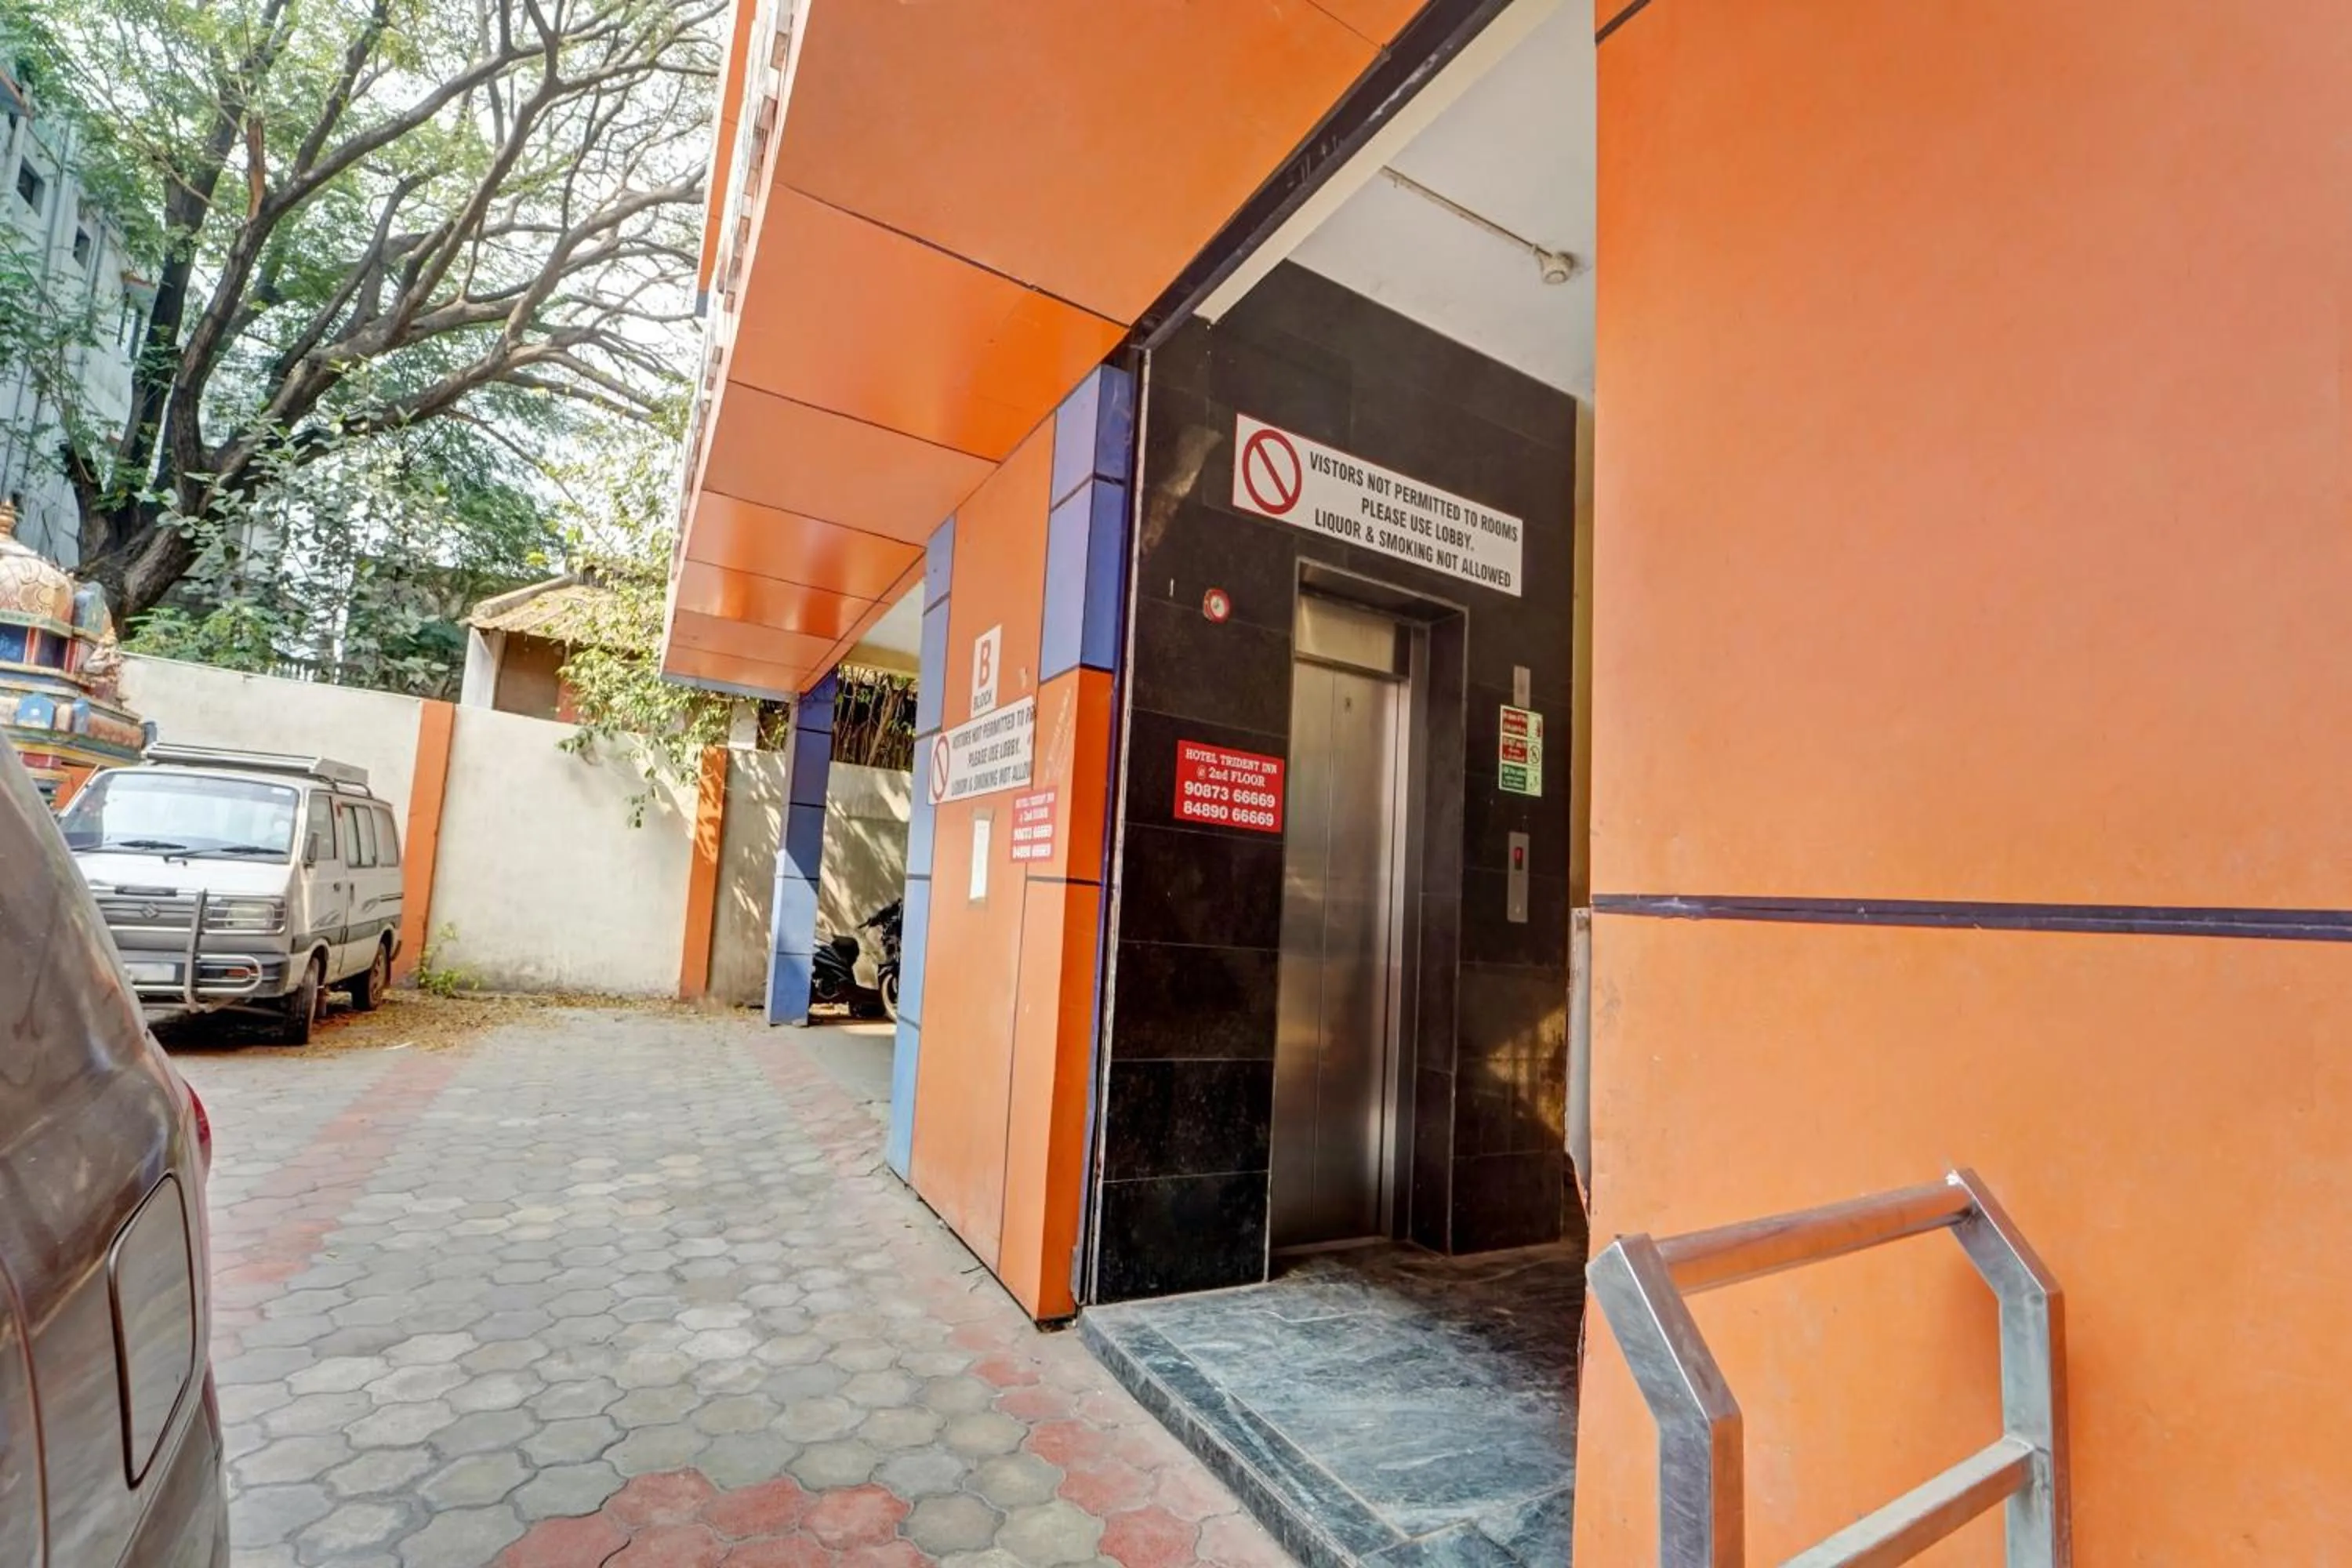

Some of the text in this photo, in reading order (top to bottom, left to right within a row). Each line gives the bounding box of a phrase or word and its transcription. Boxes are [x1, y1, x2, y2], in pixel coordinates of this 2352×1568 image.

[1310, 451, 1518, 543] VISTORS NOT PERMITTED TO ROOMS
[1361, 497, 1475, 551] PLEASE USE LOBBY.
[1315, 507, 1512, 587] LIQUOR & SMOKING NOT ALLOWED
[978, 639, 992, 688] B
[1185, 748, 1277, 774] HOTEL TRIDENT INN
[1208, 766, 1229, 781] 2nd
[1230, 771, 1265, 786] FLOOR
[1183, 800, 1275, 827] 84890 66669
[1184, 781, 1276, 808] 90873 66669
